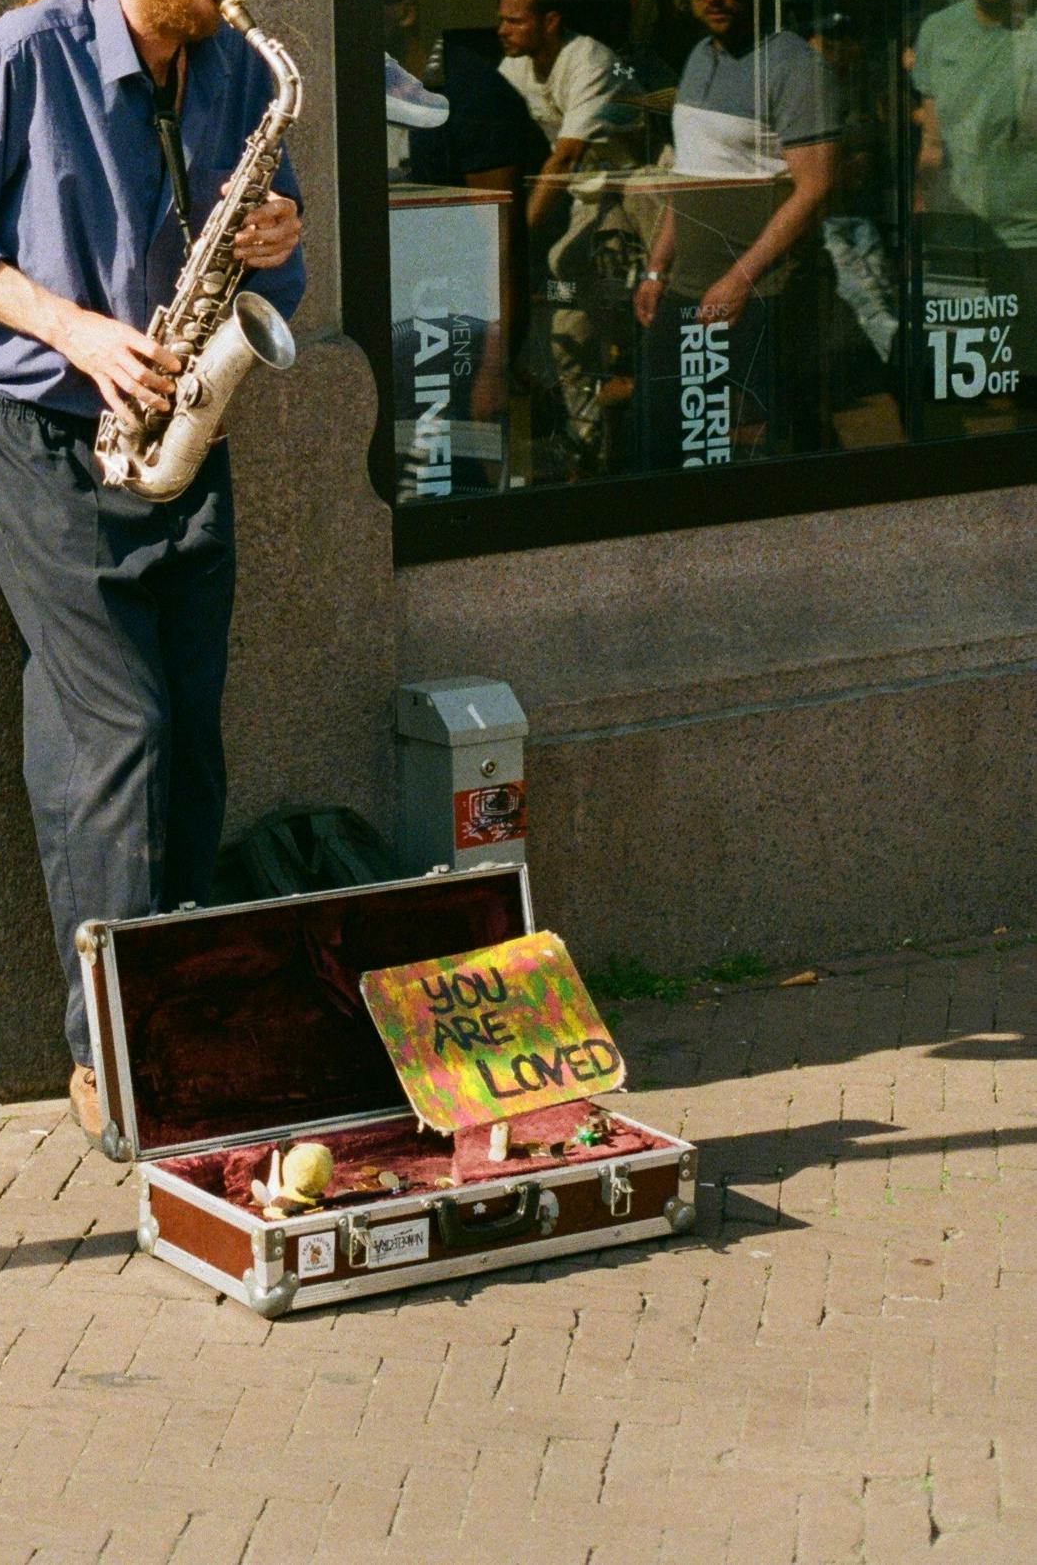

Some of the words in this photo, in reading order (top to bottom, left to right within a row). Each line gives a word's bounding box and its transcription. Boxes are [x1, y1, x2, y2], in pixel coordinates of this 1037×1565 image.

[925, 294, 1019, 323] STUDENTS
[706, 321, 729, 384] UA
[680, 324, 706, 452] REIGN
[988, 370, 1020, 394] OFF
[421, 967, 507, 1015] YOU
[434, 1010, 515, 1055] ARE
[475, 1039, 621, 1099] LOVED
